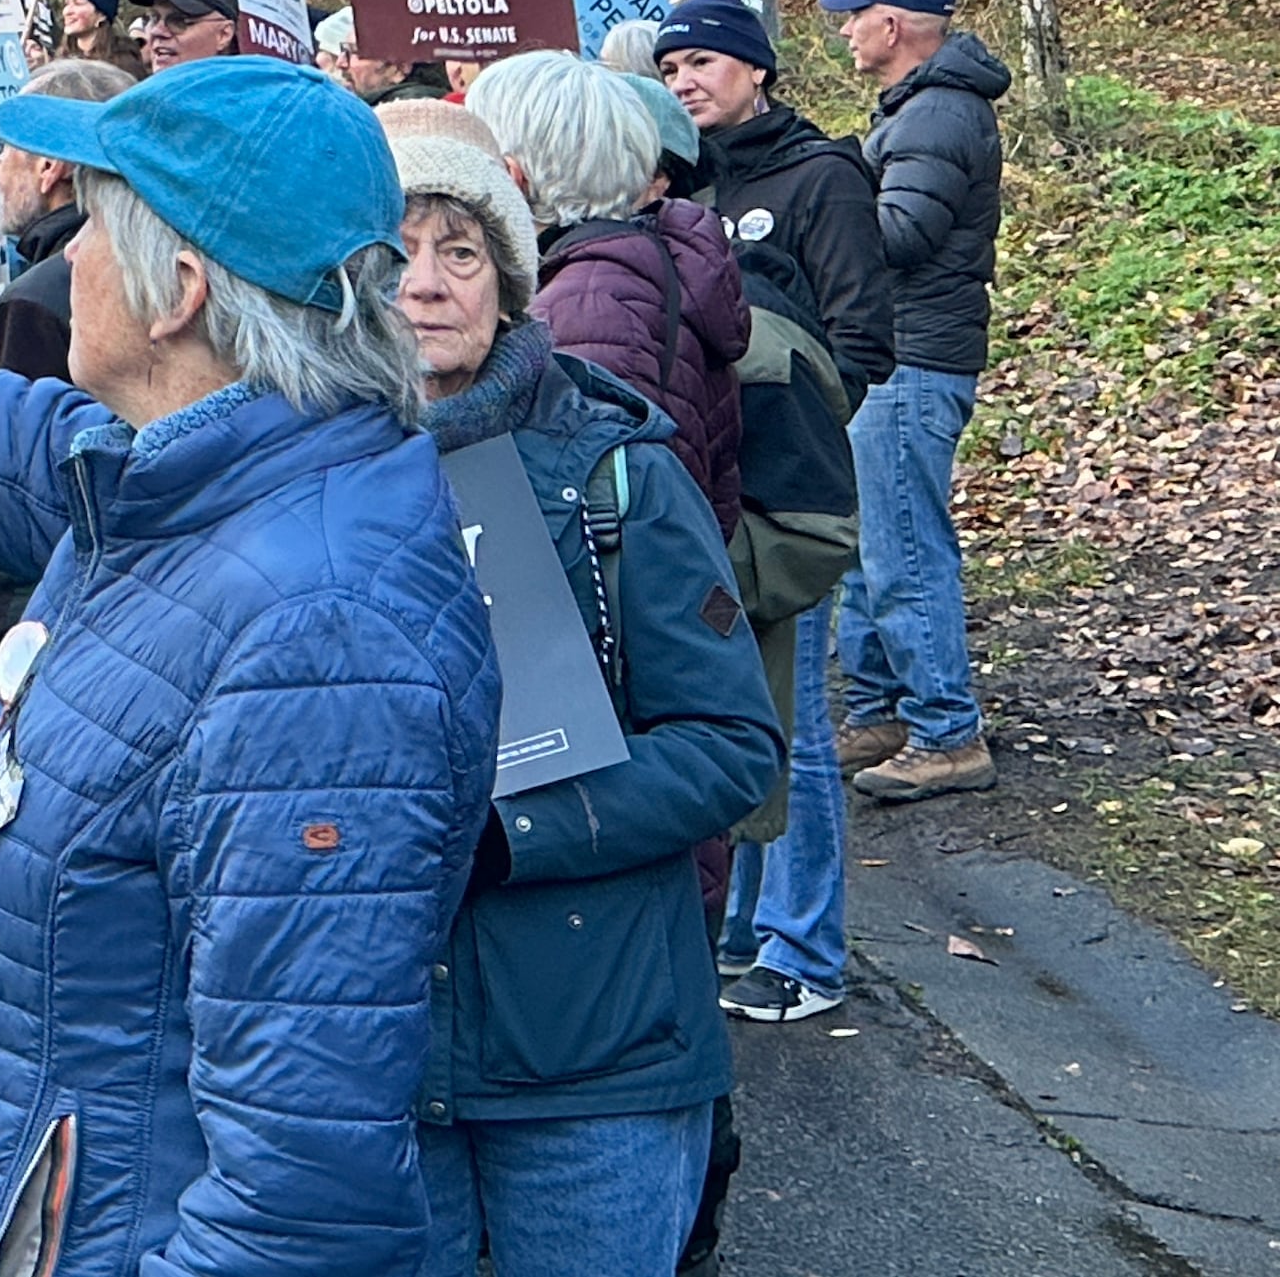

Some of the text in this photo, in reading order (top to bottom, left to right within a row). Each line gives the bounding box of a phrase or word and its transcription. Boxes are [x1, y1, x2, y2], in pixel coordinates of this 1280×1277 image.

[248, 18, 297, 62] MARY
[411, 26, 517, 44] for U.S. SENATE
